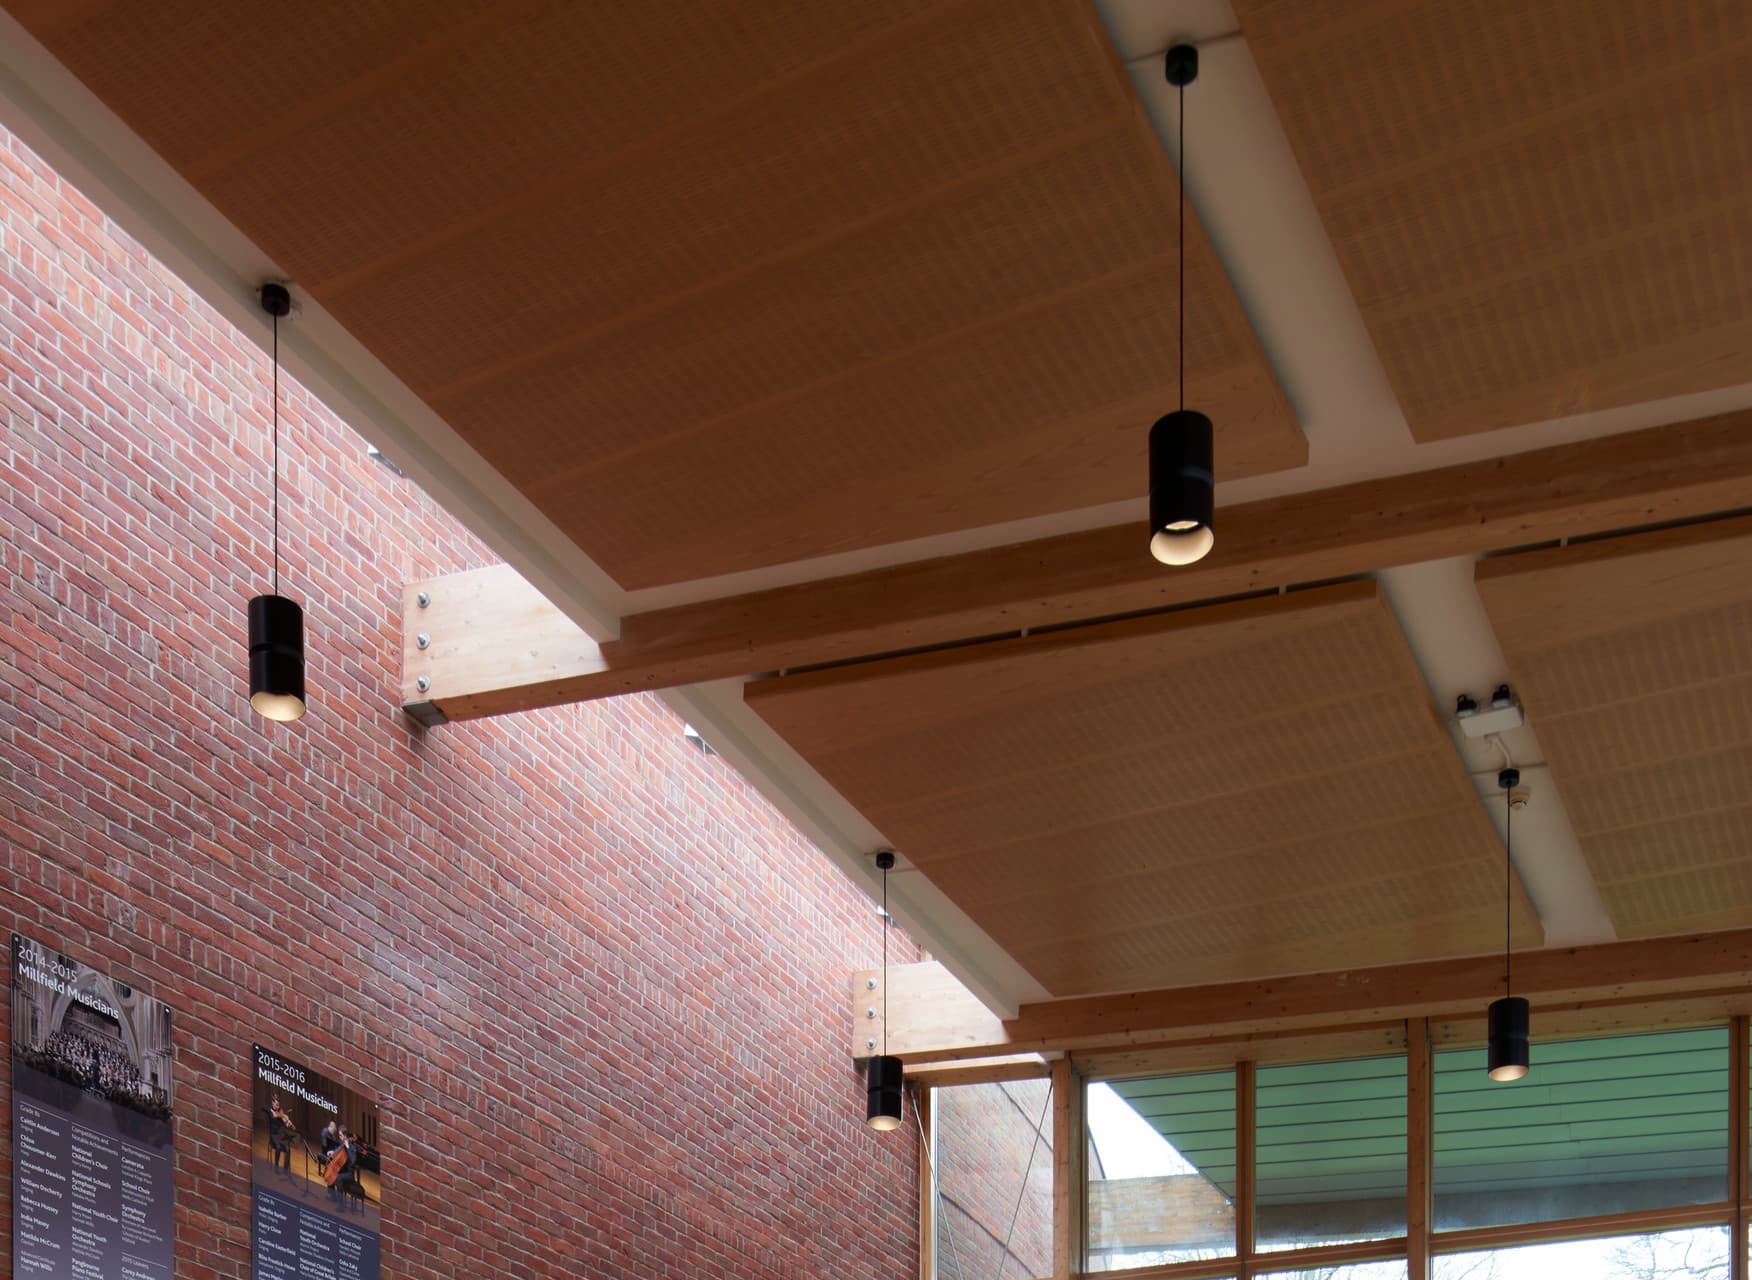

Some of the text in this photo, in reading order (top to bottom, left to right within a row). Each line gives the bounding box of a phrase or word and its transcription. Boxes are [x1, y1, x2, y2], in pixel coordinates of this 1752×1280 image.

[19, 946, 78, 983] 2014-2015
[19, 965, 119, 1019] Millfield Musicians
[258, 1052, 305, 1083] 2015-2016
[259, 1067, 338, 1114] Millfield Musicians
